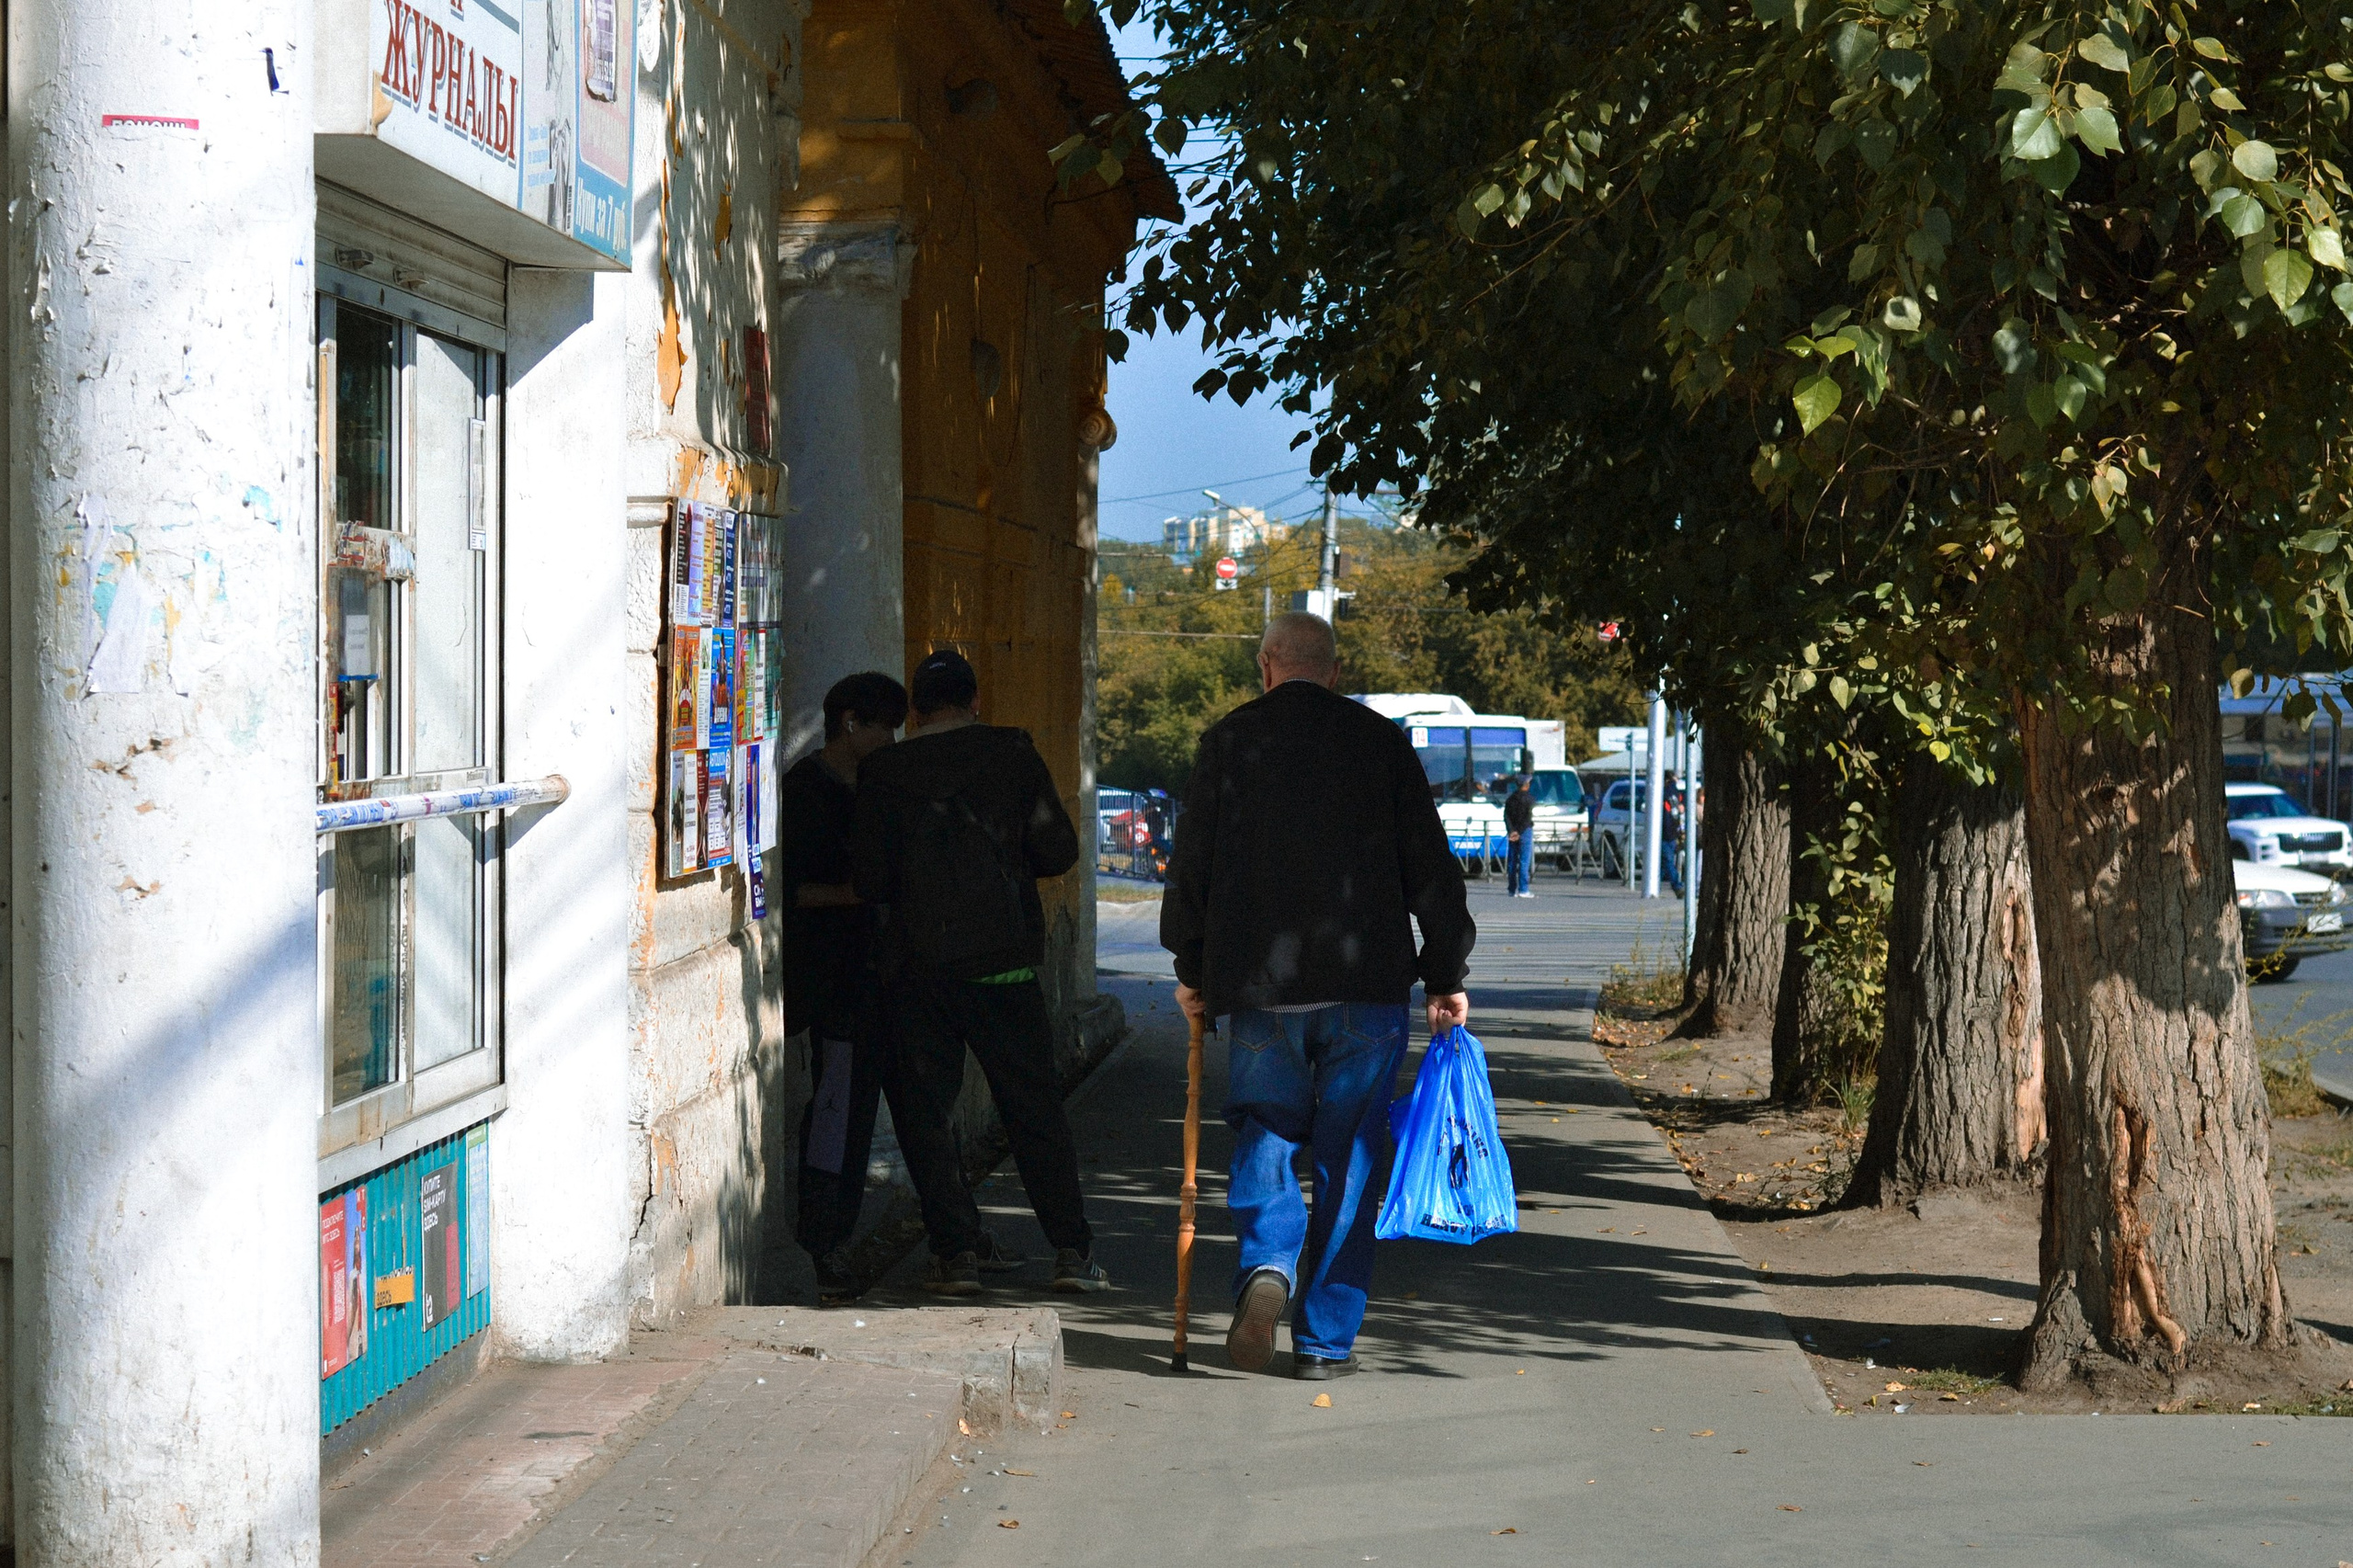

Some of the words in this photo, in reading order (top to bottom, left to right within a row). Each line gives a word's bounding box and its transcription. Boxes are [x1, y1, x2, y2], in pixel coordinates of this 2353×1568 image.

[381, 0, 519, 162] ЖУРНАЛЫ
[596, 197, 607, 239] за
[607, 194, 614, 241] 7
[424, 1211, 438, 1233] ЗДЕСЬ
